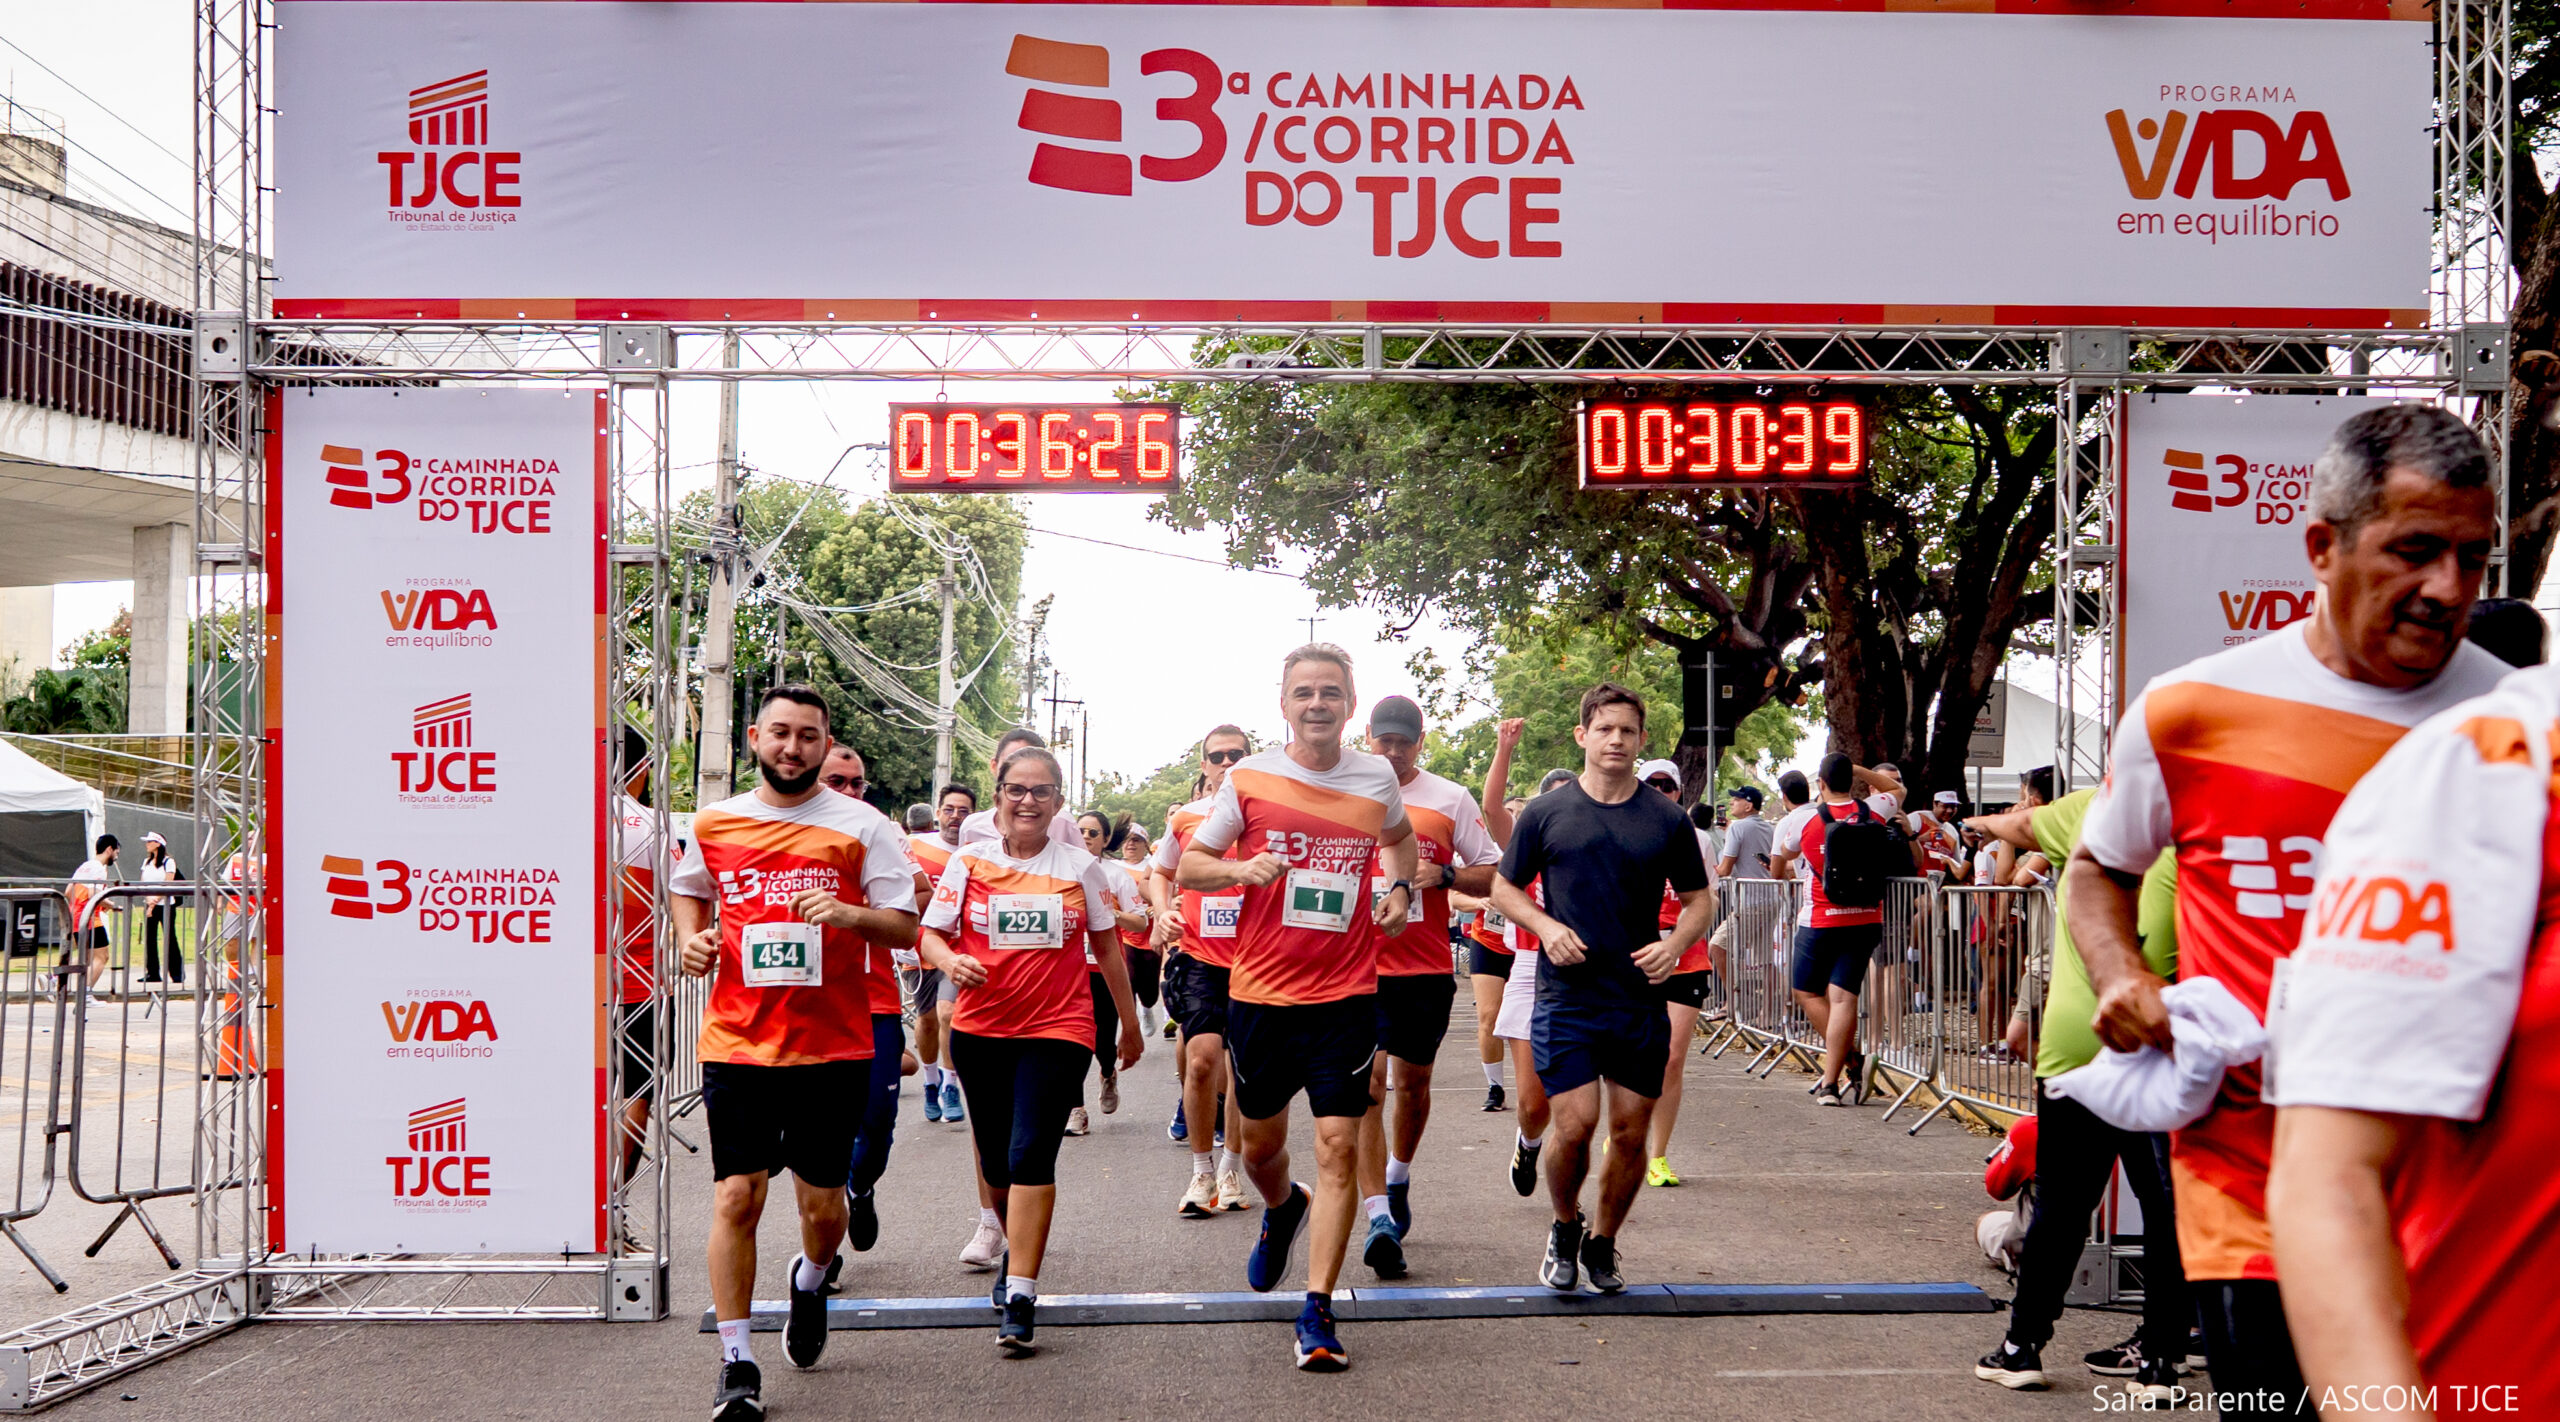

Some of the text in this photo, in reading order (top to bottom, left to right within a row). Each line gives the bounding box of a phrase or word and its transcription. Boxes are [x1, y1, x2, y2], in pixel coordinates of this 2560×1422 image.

[1267, 72, 1585, 110] CAMINHADA
[2160, 85, 2296, 103] PROGRAMA
[1244, 112, 1574, 165] /CORRIDA
[2105, 109, 2351, 202] VIDA
[378, 151, 521, 208] TJCE
[387, 211, 516, 225] Tribunal de Justiça
[1246, 171, 1561, 258] DO TJCE
[2117, 204, 2339, 245] em equilíbrio
[898, 411, 1170, 478] 00:36:26
[1592, 406, 1870, 473] 00:30:39
[428, 458, 560, 474] CAMINHADA
[418, 475, 556, 496] /CORRIDA
[419, 499, 550, 534] DO TJCE
[2256, 502, 2295, 525] DO
[406, 578, 472, 587] PROGRAMA
[2243, 579, 2305, 588] PROGRAMA
[380, 589, 498, 631] VIDA
[385, 632, 493, 651] em equilíbrio
[2224, 635, 2246, 646] em
[391, 751, 496, 793] TJCE
[398, 794, 440, 803] Tribunal
[443, 794, 456, 803] de
[428, 868, 560, 884] CAMINHADA
[769, 867, 840, 880] CAMINHADA
[419, 885, 557, 906] /CORRIDA
[765, 891, 790, 906] DO
[1315, 890, 1325, 911] 1
[420, 908, 551, 944] DO TJCE
[1005, 912, 1041, 932] 292
[758, 944, 799, 967] 454
[407, 989, 473, 998] PROGRAMA
[381, 1000, 498, 1042] VIDA
[387, 1043, 493, 1062] em equilíbrio
[386, 1156, 491, 1197] TJCE
[393, 1199, 434, 1207] Tribunal
[438, 1199, 450, 1207] de
